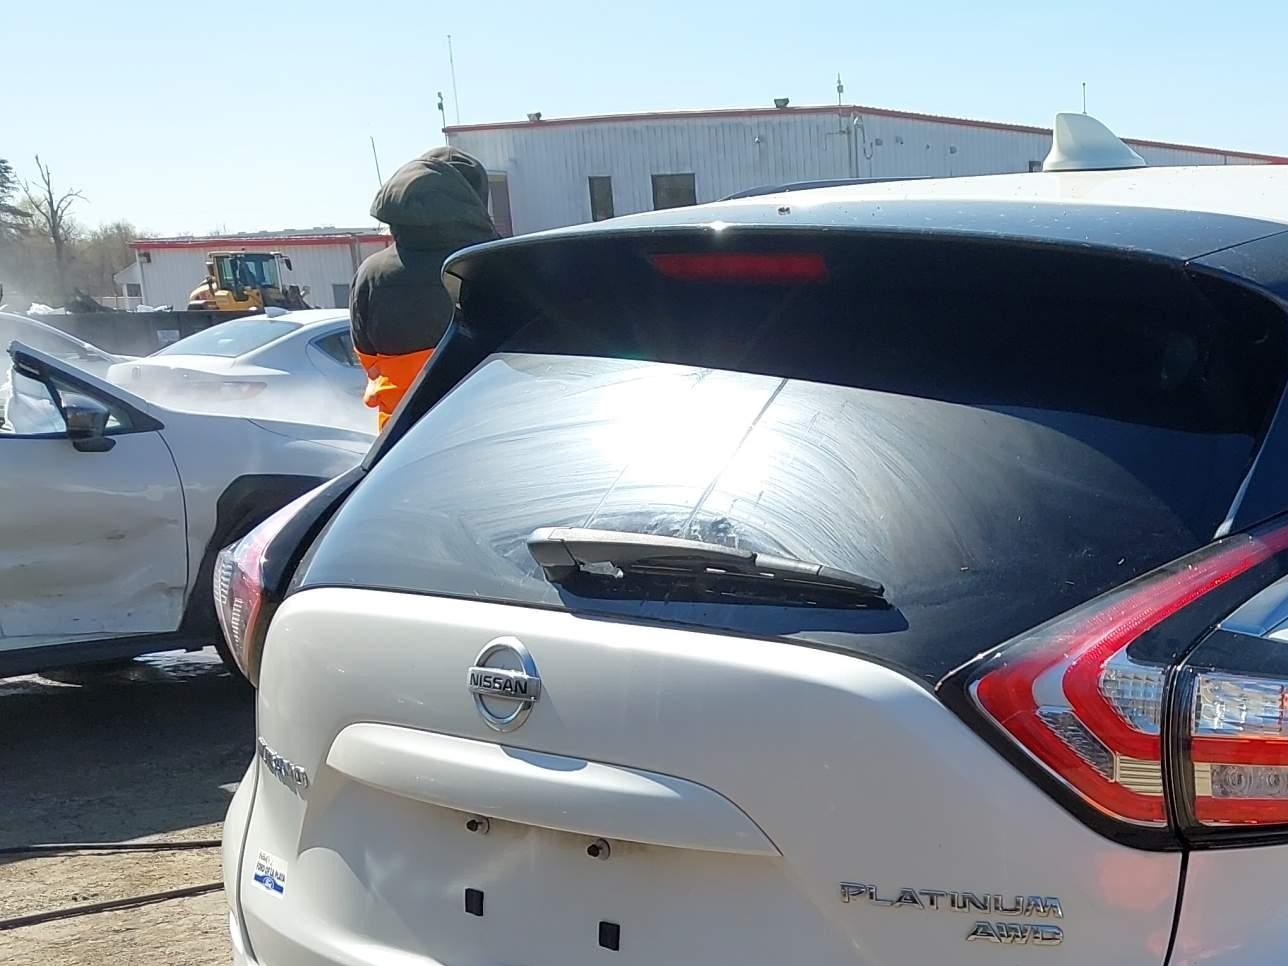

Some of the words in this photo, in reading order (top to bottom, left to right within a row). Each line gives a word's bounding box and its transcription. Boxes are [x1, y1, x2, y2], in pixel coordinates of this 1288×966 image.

[469, 672, 529, 695] NISSAN
[839, 881, 1064, 919] PLATINUM
[967, 920, 1064, 946] AWD
